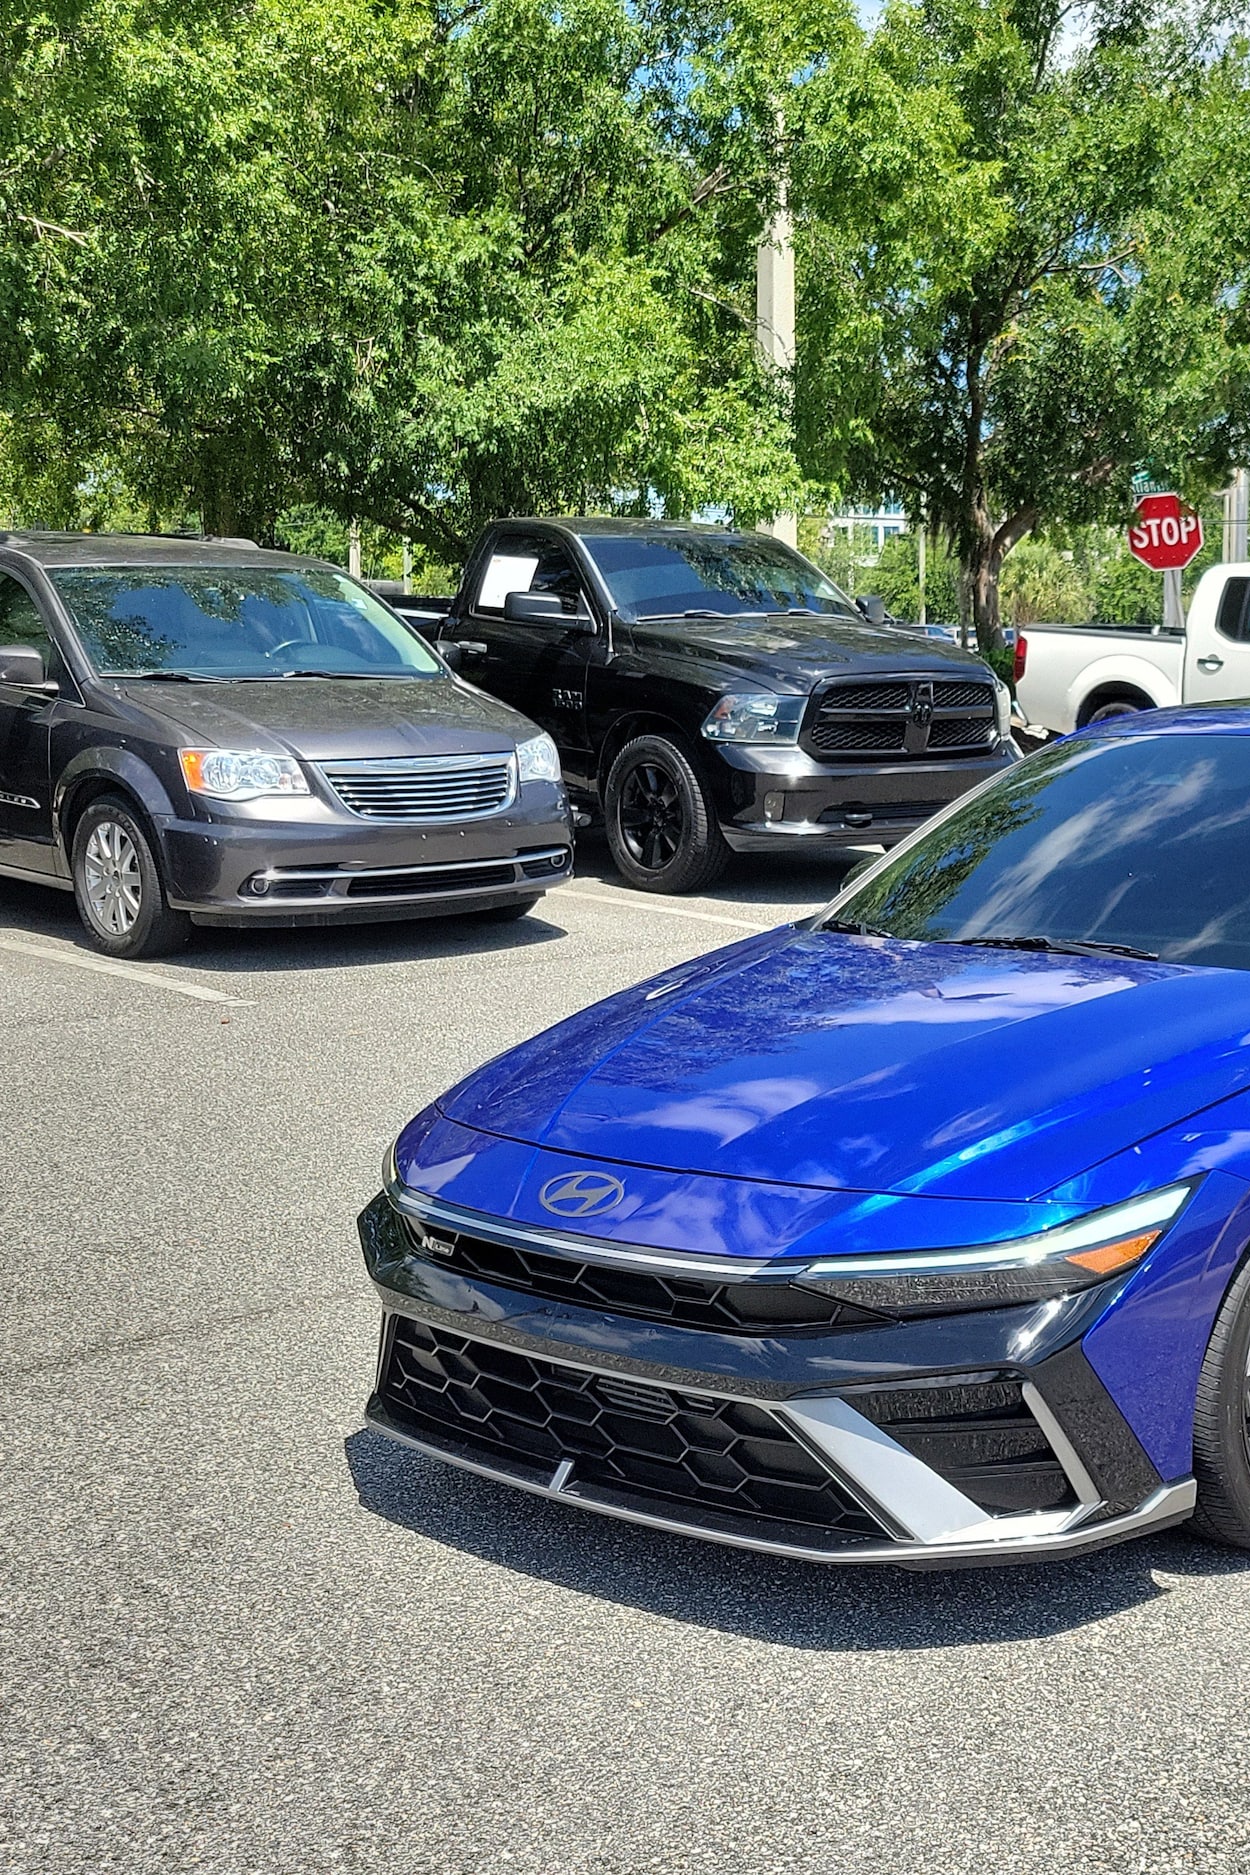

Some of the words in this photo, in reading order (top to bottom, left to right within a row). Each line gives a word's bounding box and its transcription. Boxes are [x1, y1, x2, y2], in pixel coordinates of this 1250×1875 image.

[1132, 516, 1197, 549] STOP
[552, 688, 583, 700] RAM
[422, 1235, 435, 1251] N
